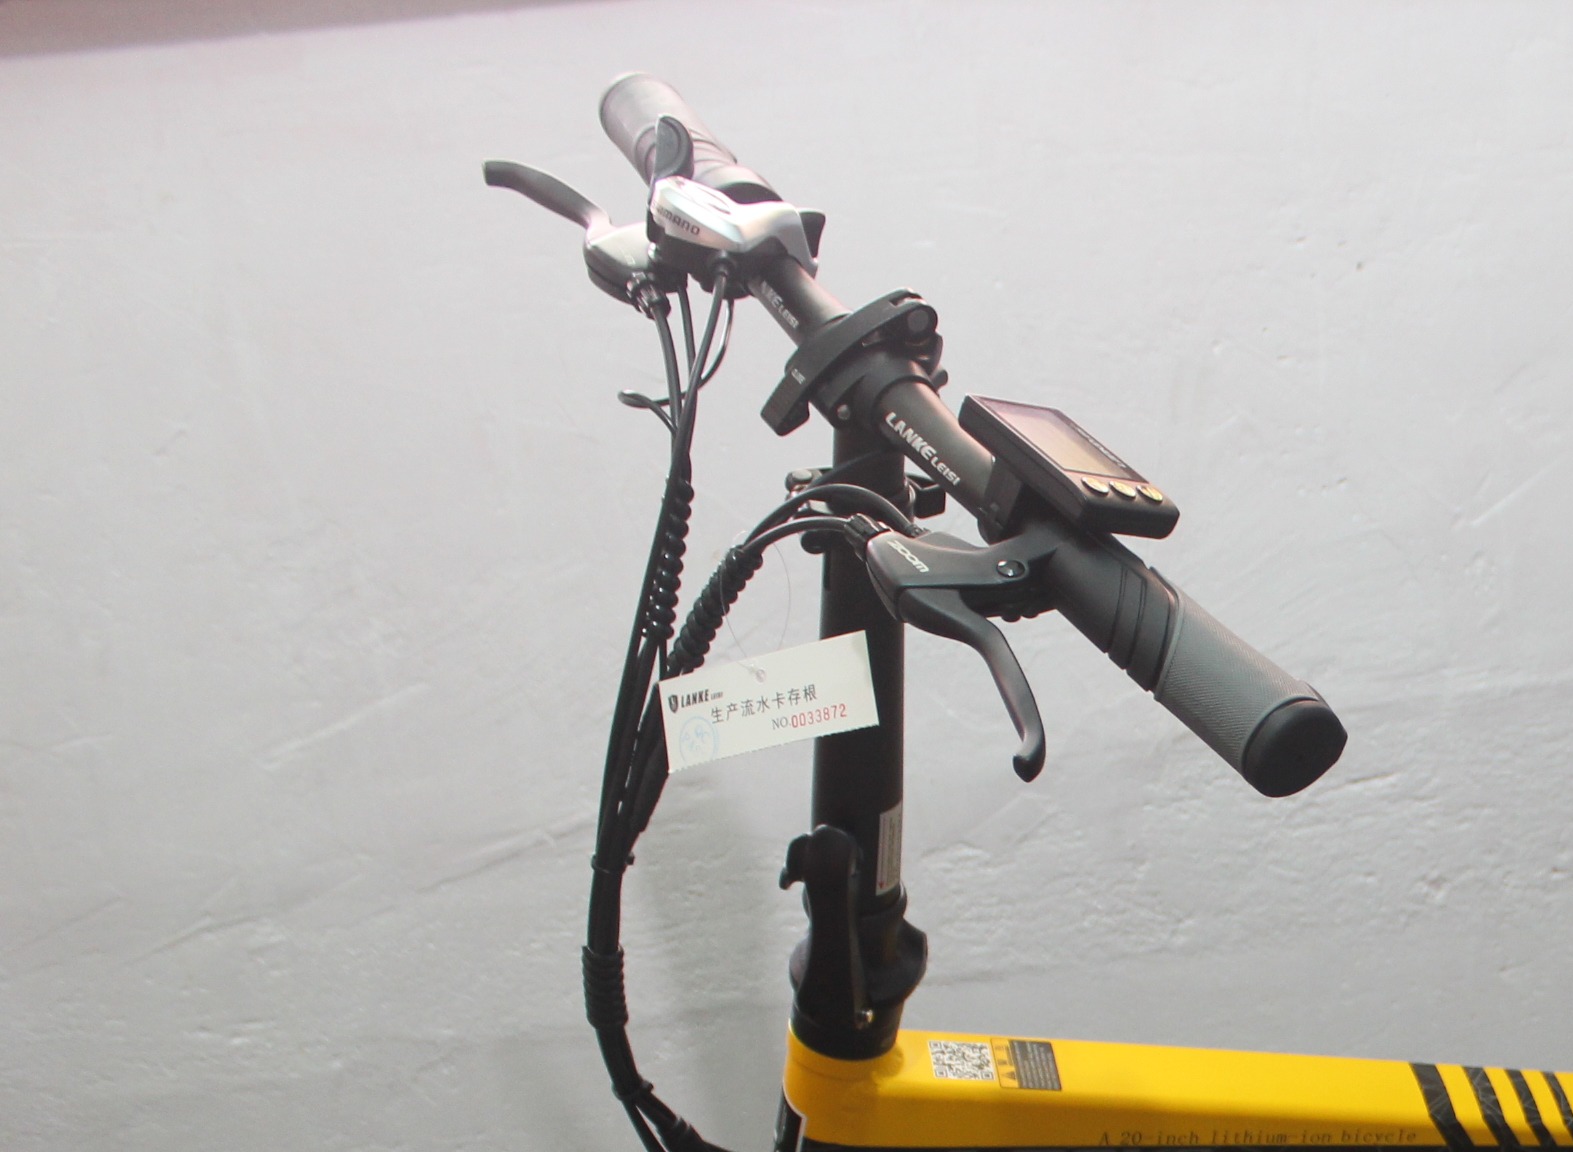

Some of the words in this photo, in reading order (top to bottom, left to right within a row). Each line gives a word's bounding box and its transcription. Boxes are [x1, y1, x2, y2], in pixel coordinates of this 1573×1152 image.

[710, 684, 818, 724] 生产流水卡存根
[1341, 1129, 1417, 1145] bicycle
